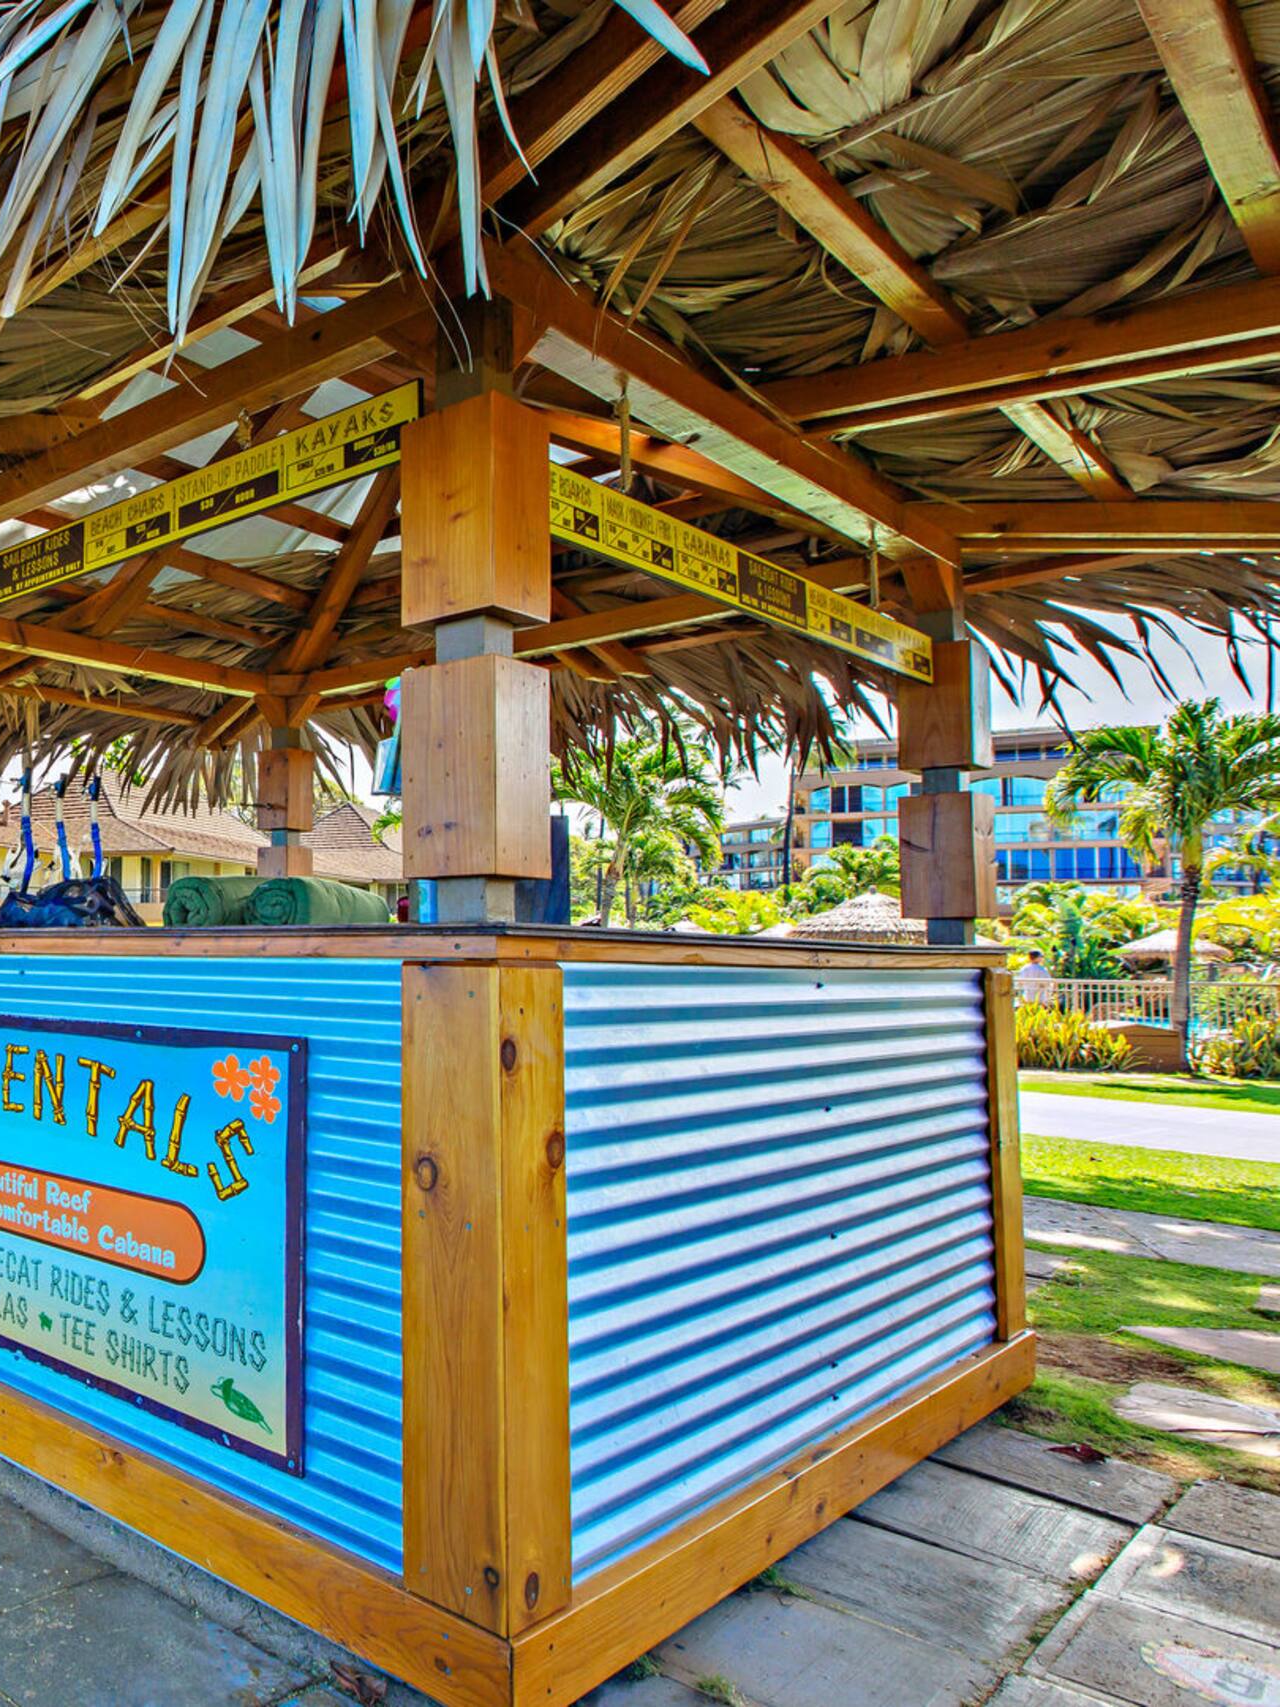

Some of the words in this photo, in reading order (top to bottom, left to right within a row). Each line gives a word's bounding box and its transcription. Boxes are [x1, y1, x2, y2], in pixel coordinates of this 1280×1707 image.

[294, 401, 395, 457] KAYAKS
[234, 445, 277, 481] PADDLE
[21, 551, 60, 578] LESSONS
[44, 1180, 93, 1215] Reef
[97, 1225, 177, 1270] Cabana
[49, 1263, 111, 1318] RIDES
[119, 1287, 139, 1327] &
[147, 1295, 269, 1374] LESSONS
[59, 1311, 97, 1357] TEE
[105, 1328, 191, 1396] SHIRTS
